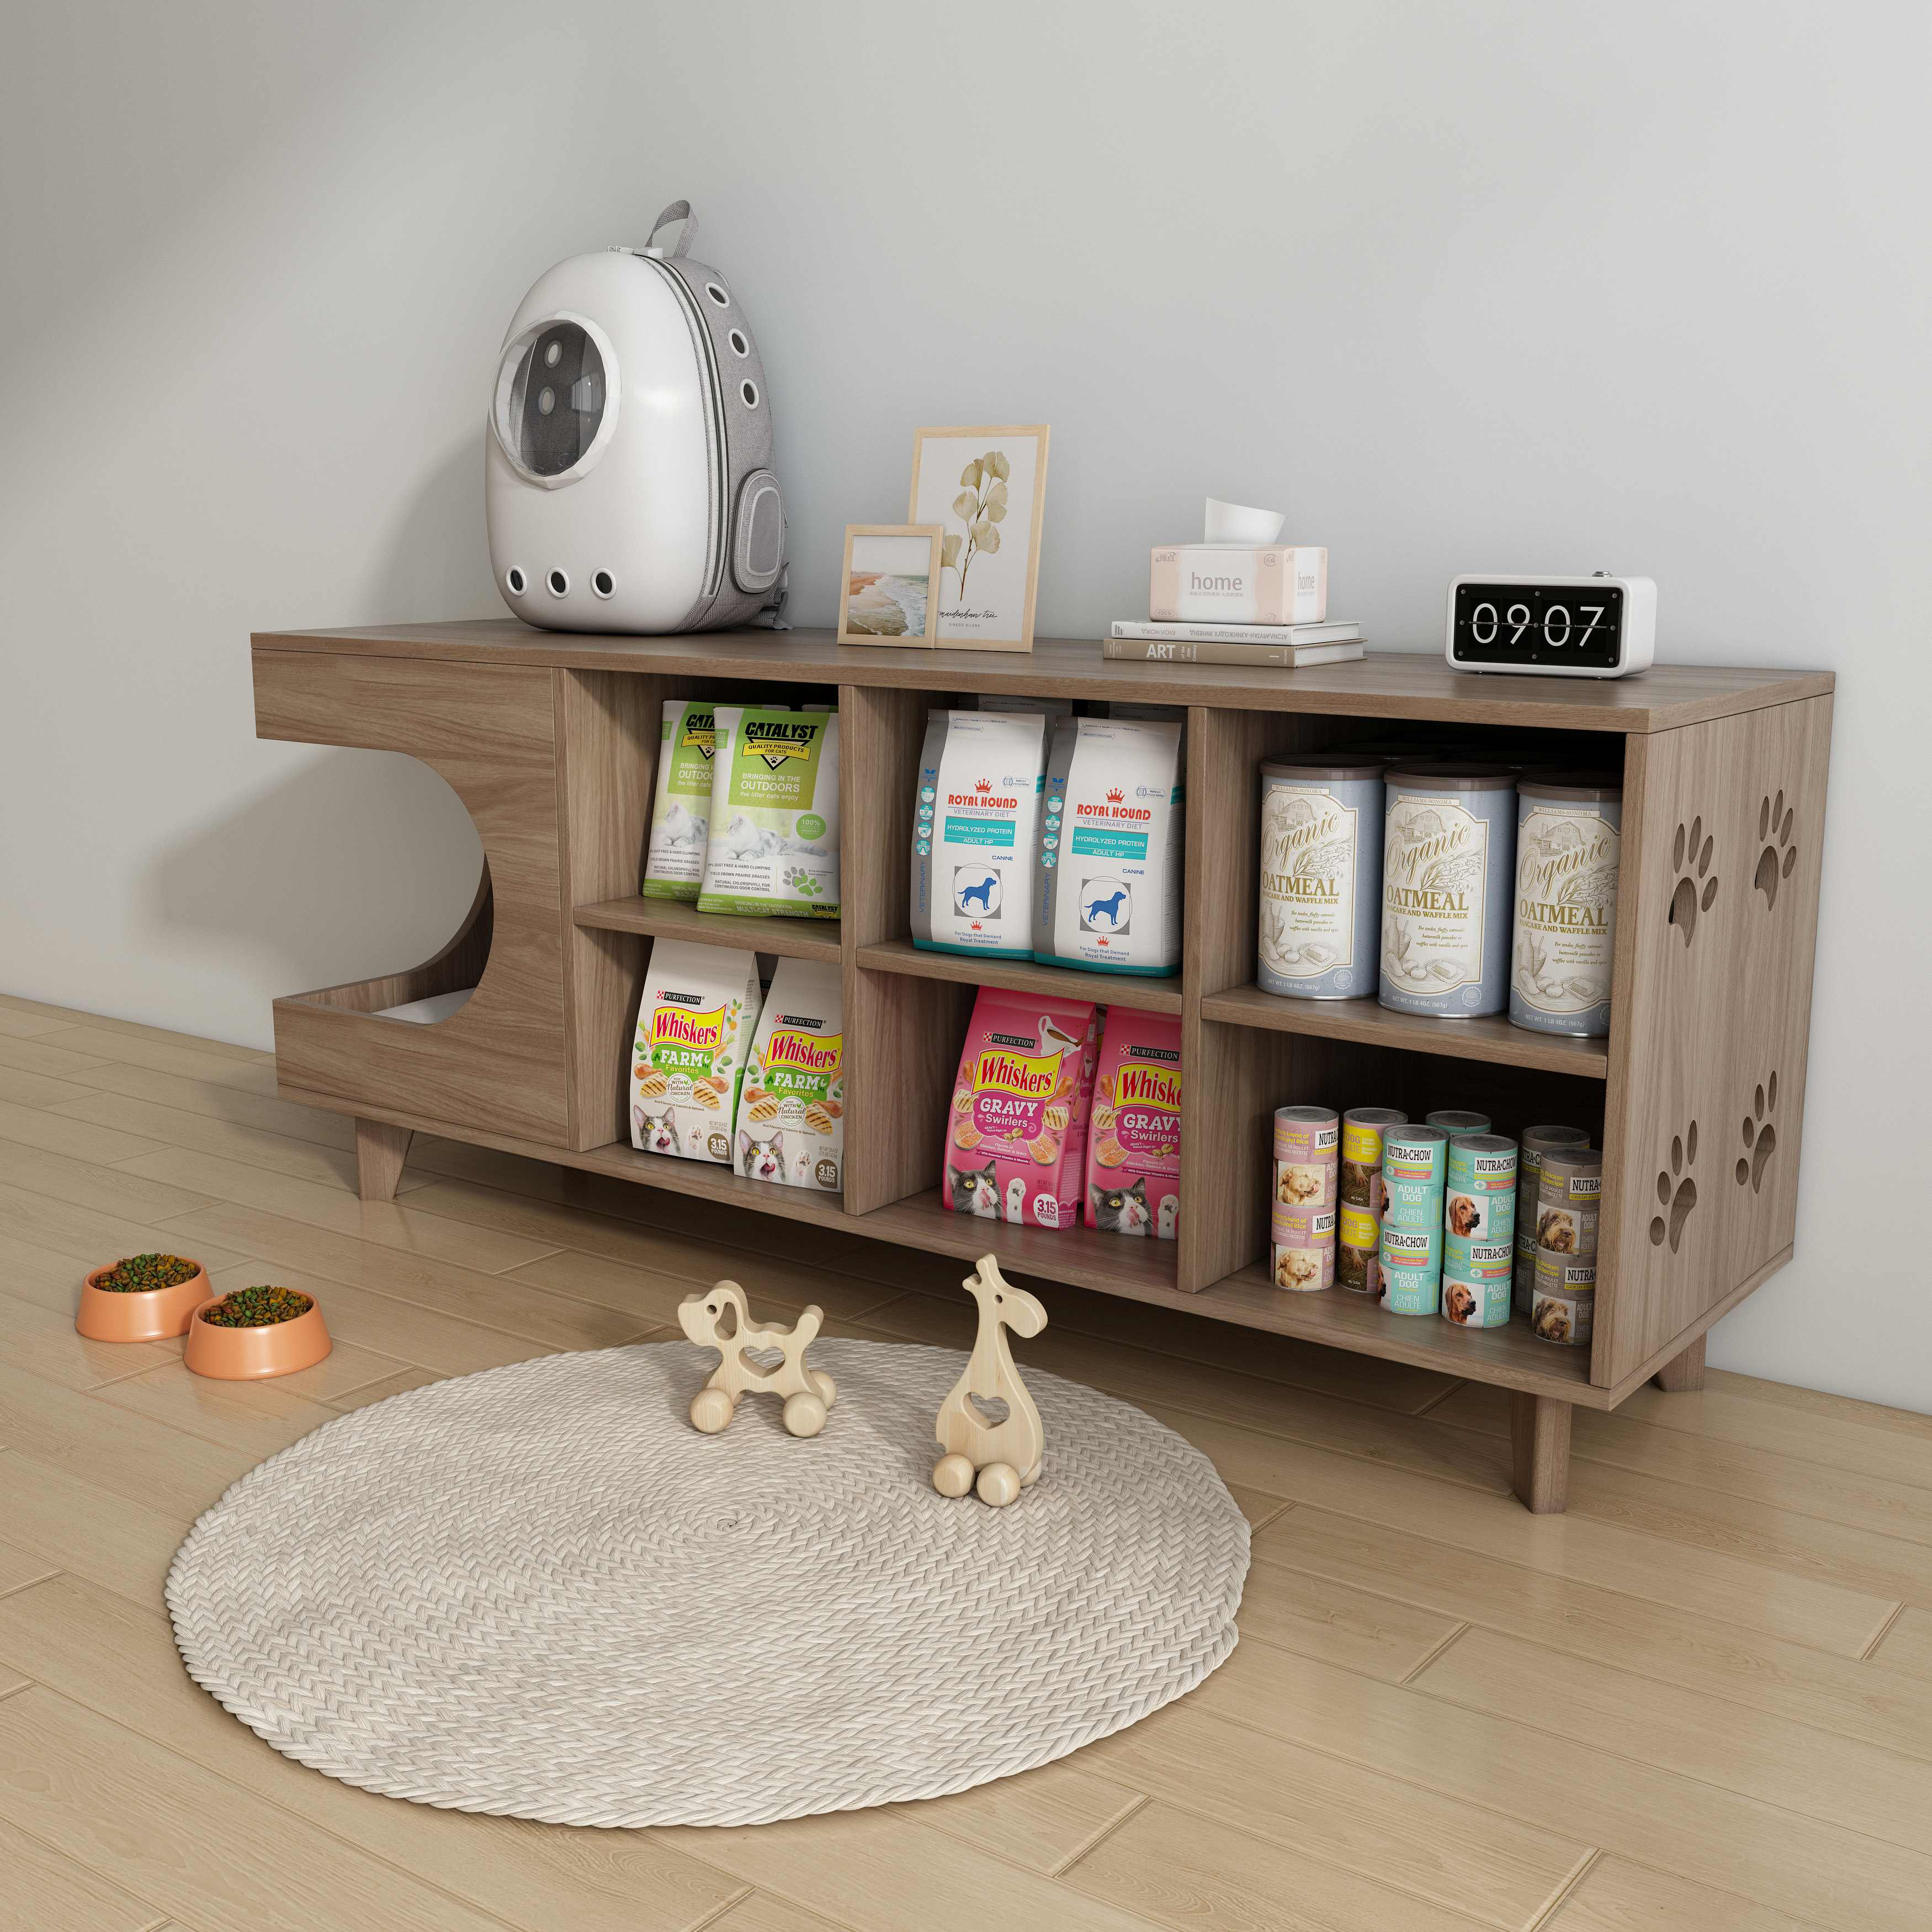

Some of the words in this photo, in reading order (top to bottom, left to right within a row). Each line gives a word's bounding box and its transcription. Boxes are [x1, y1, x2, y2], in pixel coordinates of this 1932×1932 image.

[1192, 572, 1242, 591] home
[1298, 570, 1314, 590] home
[983, 610, 997, 618] tree
[1146, 644, 1175, 658] ART
[745, 723, 818, 739] CATALYST
[741, 781, 799, 792] OUTDOORS
[948, 794, 978, 807] ROYAL
[981, 797, 1017, 809] HOUND
[1078, 804, 1108, 817] ROYAL
[1112, 807, 1150, 820] HOUND
[1538, 808, 1591, 816] WILLIAMS-SONOMA
[948, 825, 985, 833] HYDROLYZED
[1083, 819, 1126, 828] VETERINARY
[1076, 836, 1116, 845] HYDROLYZED
[1262, 811, 1339, 871] Organic
[1387, 823, 1470, 884] Organic
[1520, 835, 1610, 899] Organic
[1262, 871, 1339, 896] OATMEAL
[1042, 873, 1051, 926] VETERINARY
[1387, 885, 1469, 910] OATMEAL
[1520, 899, 1608, 926] OATMEAL
[1520, 919, 1541, 930] PANCAKE
[665, 993, 700, 1003] PURFECTION
[656, 1012, 717, 1044] Whiskers
[784, 1017, 821, 1027] PURFECTION
[1569, 1020, 1585, 1028] (567g)
[993, 1035, 1033, 1047] PURFECTION
[771, 1035, 837, 1068] Whiskers
[1132, 1048, 1179, 1059] PURFECTION
[661, 1050, 704, 1066] FARM
[666, 1064, 698, 1073] Favorites
[981, 1057, 1052, 1092] Whiskers
[773, 1073, 820, 1090] FARM
[779, 1087, 813, 1097] Favorites
[980, 1098, 1038, 1117] GRAVY
[985, 1114, 1027, 1127] Swirlers
[1130, 1130, 1179, 1142] Swirlers
[711, 1138, 726, 1150] 3.15
[819, 1164, 835, 1177] 3.15
[1398, 1185, 1427, 1194] ADULT
[1403, 1193, 1422, 1202] DOG
[1492, 1194, 1514, 1205] ADULT
[1038, 1199, 1056, 1214] 3.15
[1038, 1212, 1056, 1220] POUNDS
[1494, 1218, 1511, 1227] CHIEN
[1394, 1272, 1424, 1281] ADULT
[1488, 1281, 1510, 1293] ADULT
[1492, 1292, 1506, 1300] DOG
[1490, 1305, 1506, 1314] CHIEN
